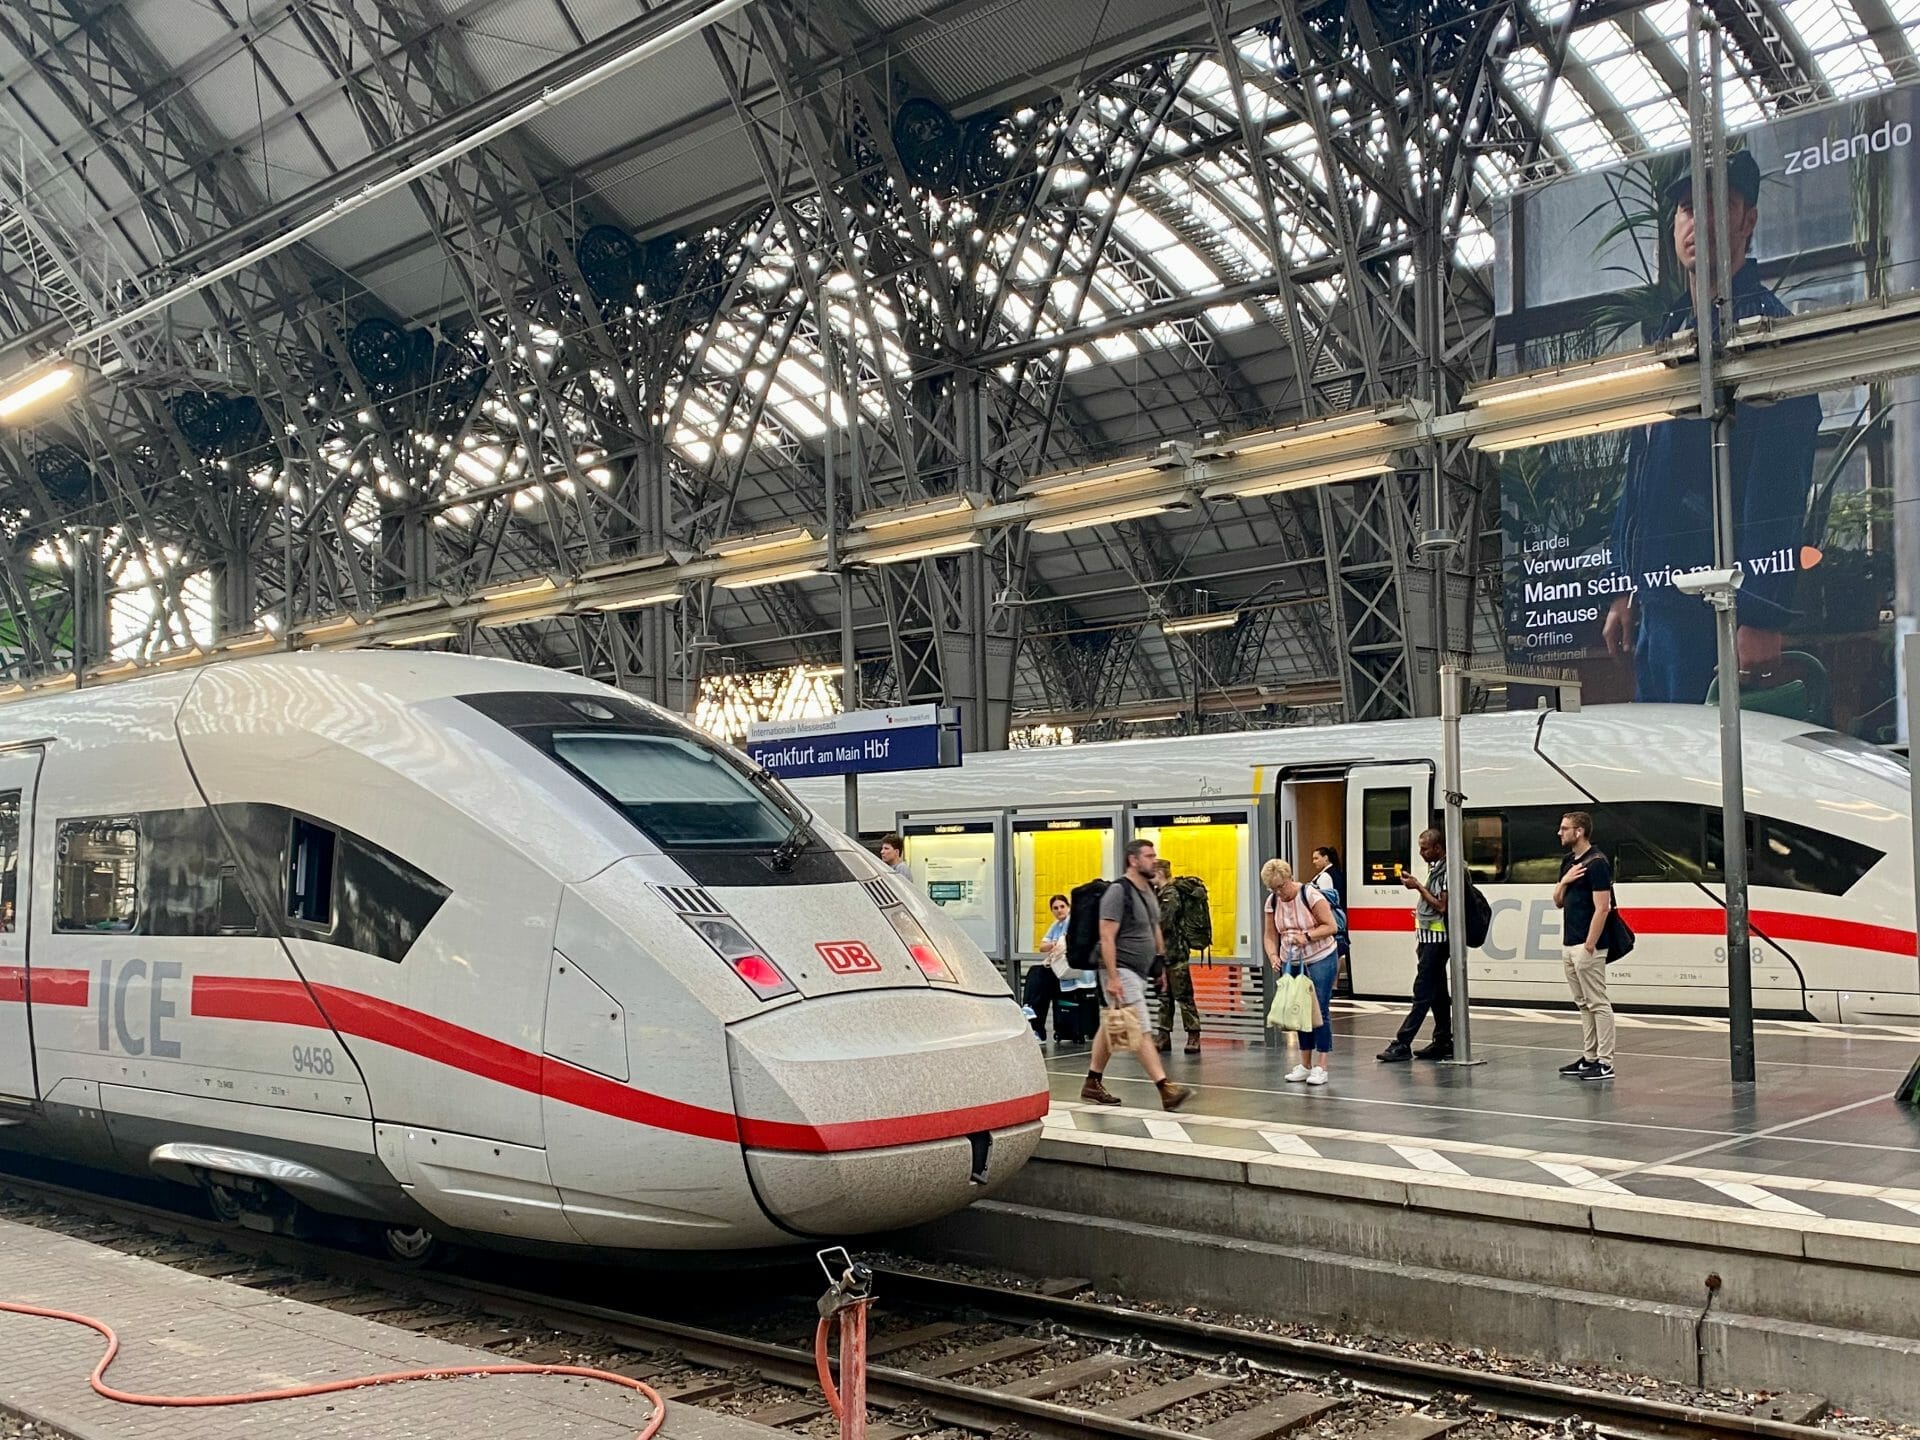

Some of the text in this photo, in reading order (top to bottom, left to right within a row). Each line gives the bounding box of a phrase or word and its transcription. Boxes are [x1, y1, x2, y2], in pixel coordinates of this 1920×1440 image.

[1784, 120, 1912, 175] zalando
[1523, 533, 1570, 553] Landei
[1523, 548, 1612, 575] Verwurzelt
[1525, 582, 1581, 603] Mann
[1587, 571, 1638, 594] sein,
[1749, 548, 1795, 575] will
[1525, 607, 1598, 628] Zuhause
[1527, 631, 1573, 648] Offline
[751, 721, 837, 737] Internationale Messestadt
[754, 738, 890, 768] Frankfurt am Main Hbf
[1481, 899, 1563, 960] CE
[822, 945, 873, 969] DB
[1714, 946, 1763, 964] 98
[98, 958, 183, 1059] ICE
[292, 1045, 335, 1076] 9458
